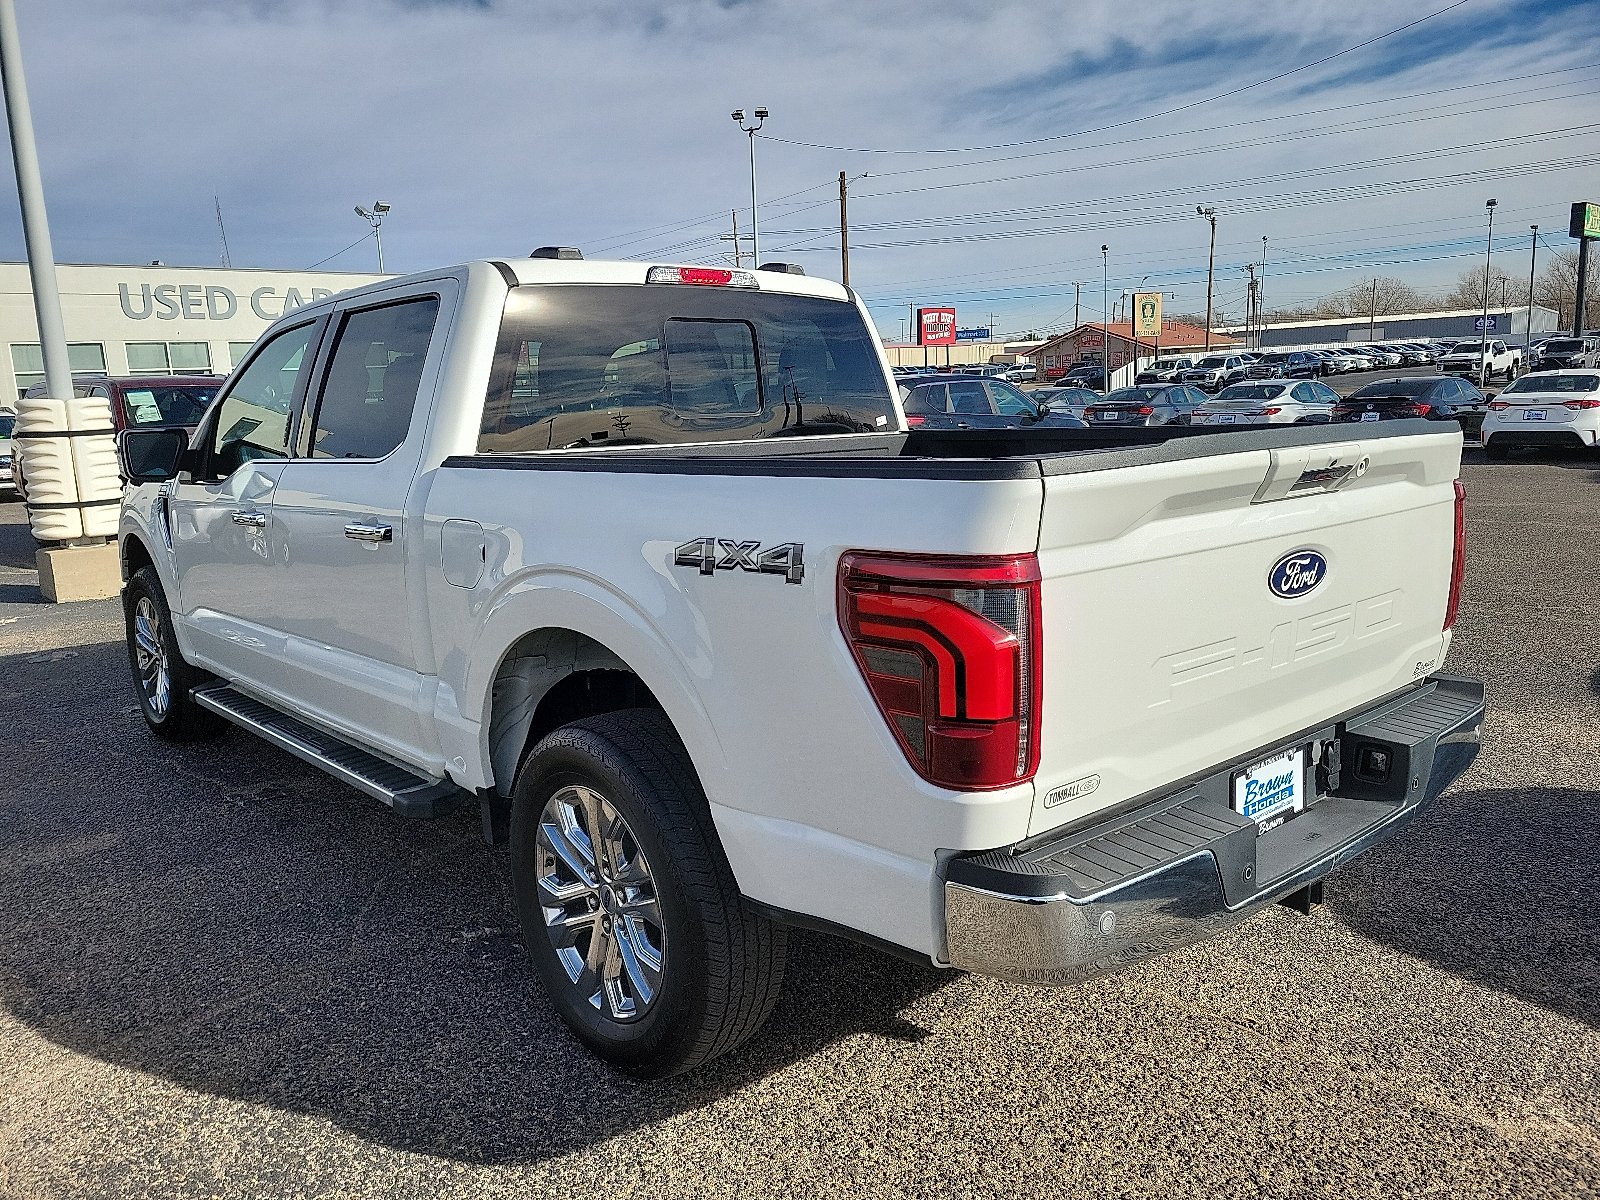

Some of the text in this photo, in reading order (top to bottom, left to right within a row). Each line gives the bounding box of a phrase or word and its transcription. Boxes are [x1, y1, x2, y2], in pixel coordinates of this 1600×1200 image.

[118, 282, 351, 321] USED CA
[1281, 557, 1320, 592] Ford
[1147, 588, 1402, 709] F-150
[1048, 783, 1080, 806] TOMBALL
[1244, 769, 1295, 806] Brown
[1248, 789, 1291, 817] Honda
[1258, 816, 1285, 836] Brown
